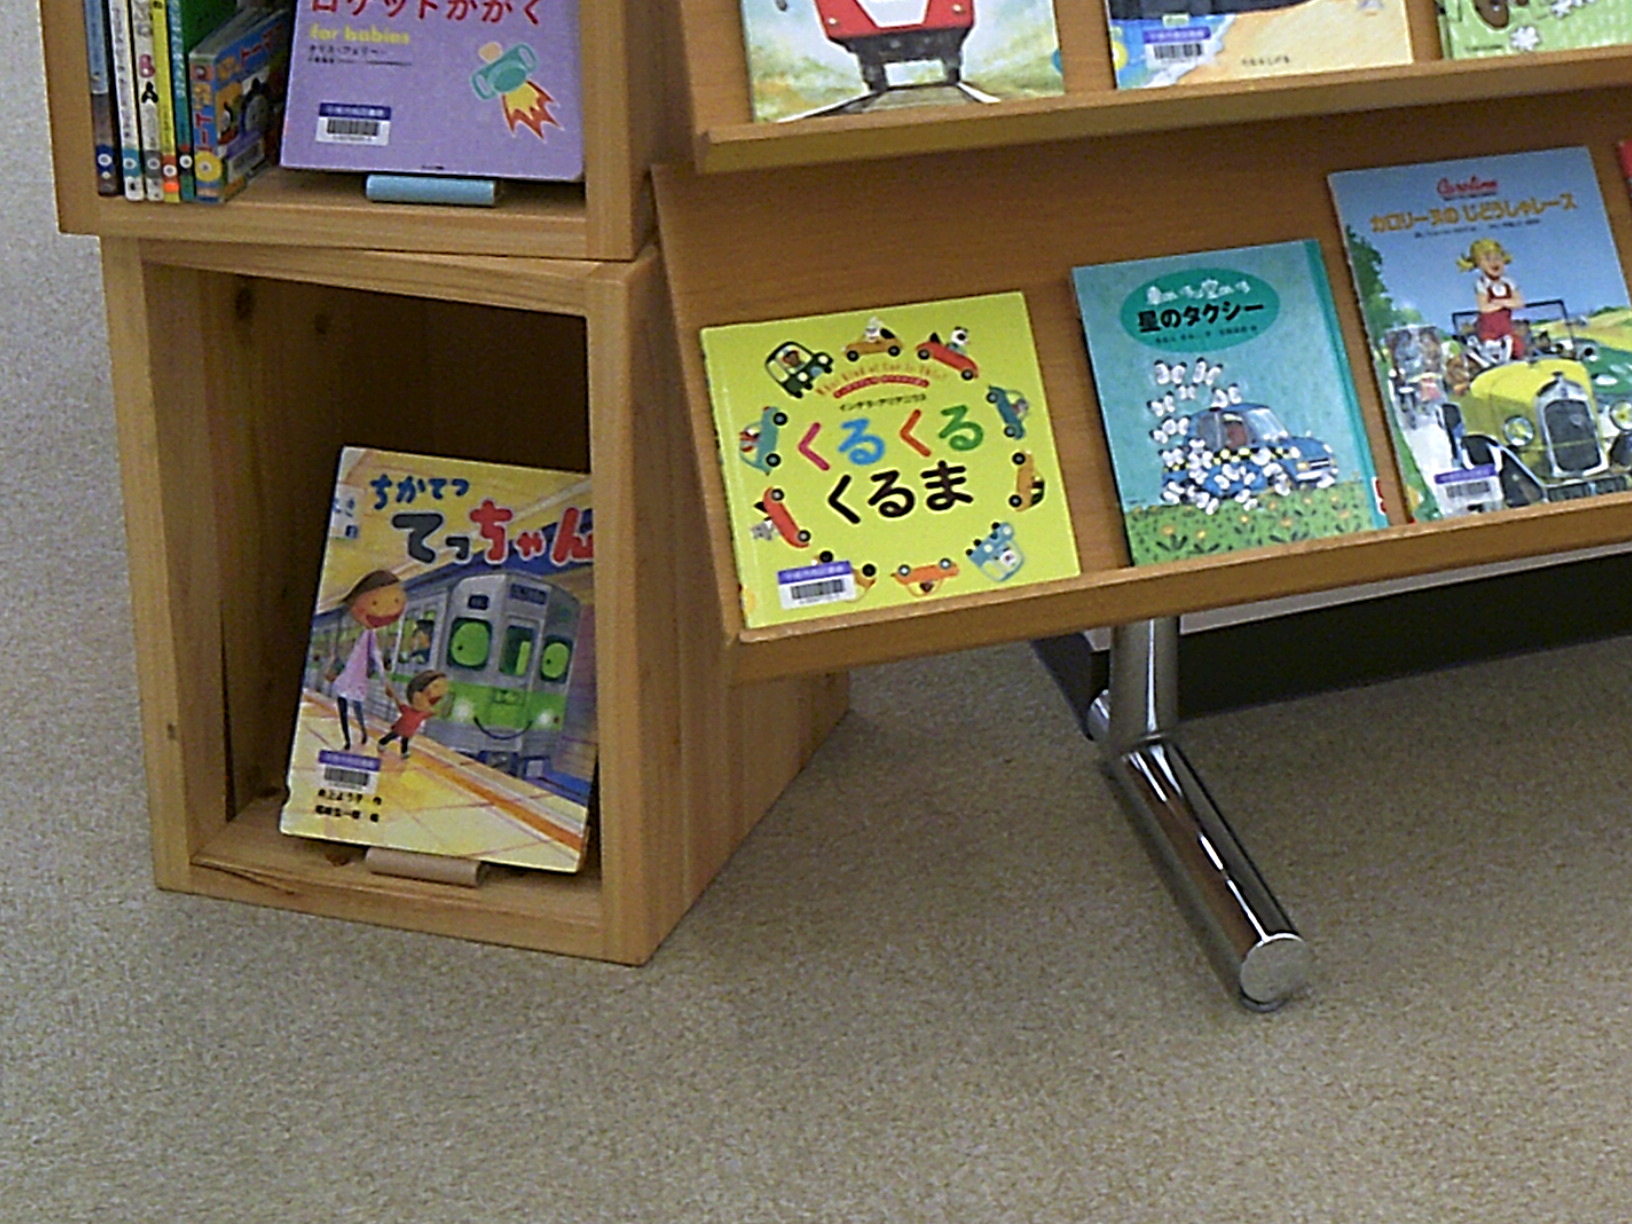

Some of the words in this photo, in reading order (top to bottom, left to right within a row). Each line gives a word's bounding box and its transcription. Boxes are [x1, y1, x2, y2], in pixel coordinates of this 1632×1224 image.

[310, 22, 338, 42] for
[344, 25, 411, 46] babies
[1137, 301, 1265, 333] 星のタクシー
[797, 403, 985, 473] くるくる
[369, 473, 471, 511] ちかてつ
[827, 459, 975, 525] くるま
[391, 498, 594, 566] てっちゃん
